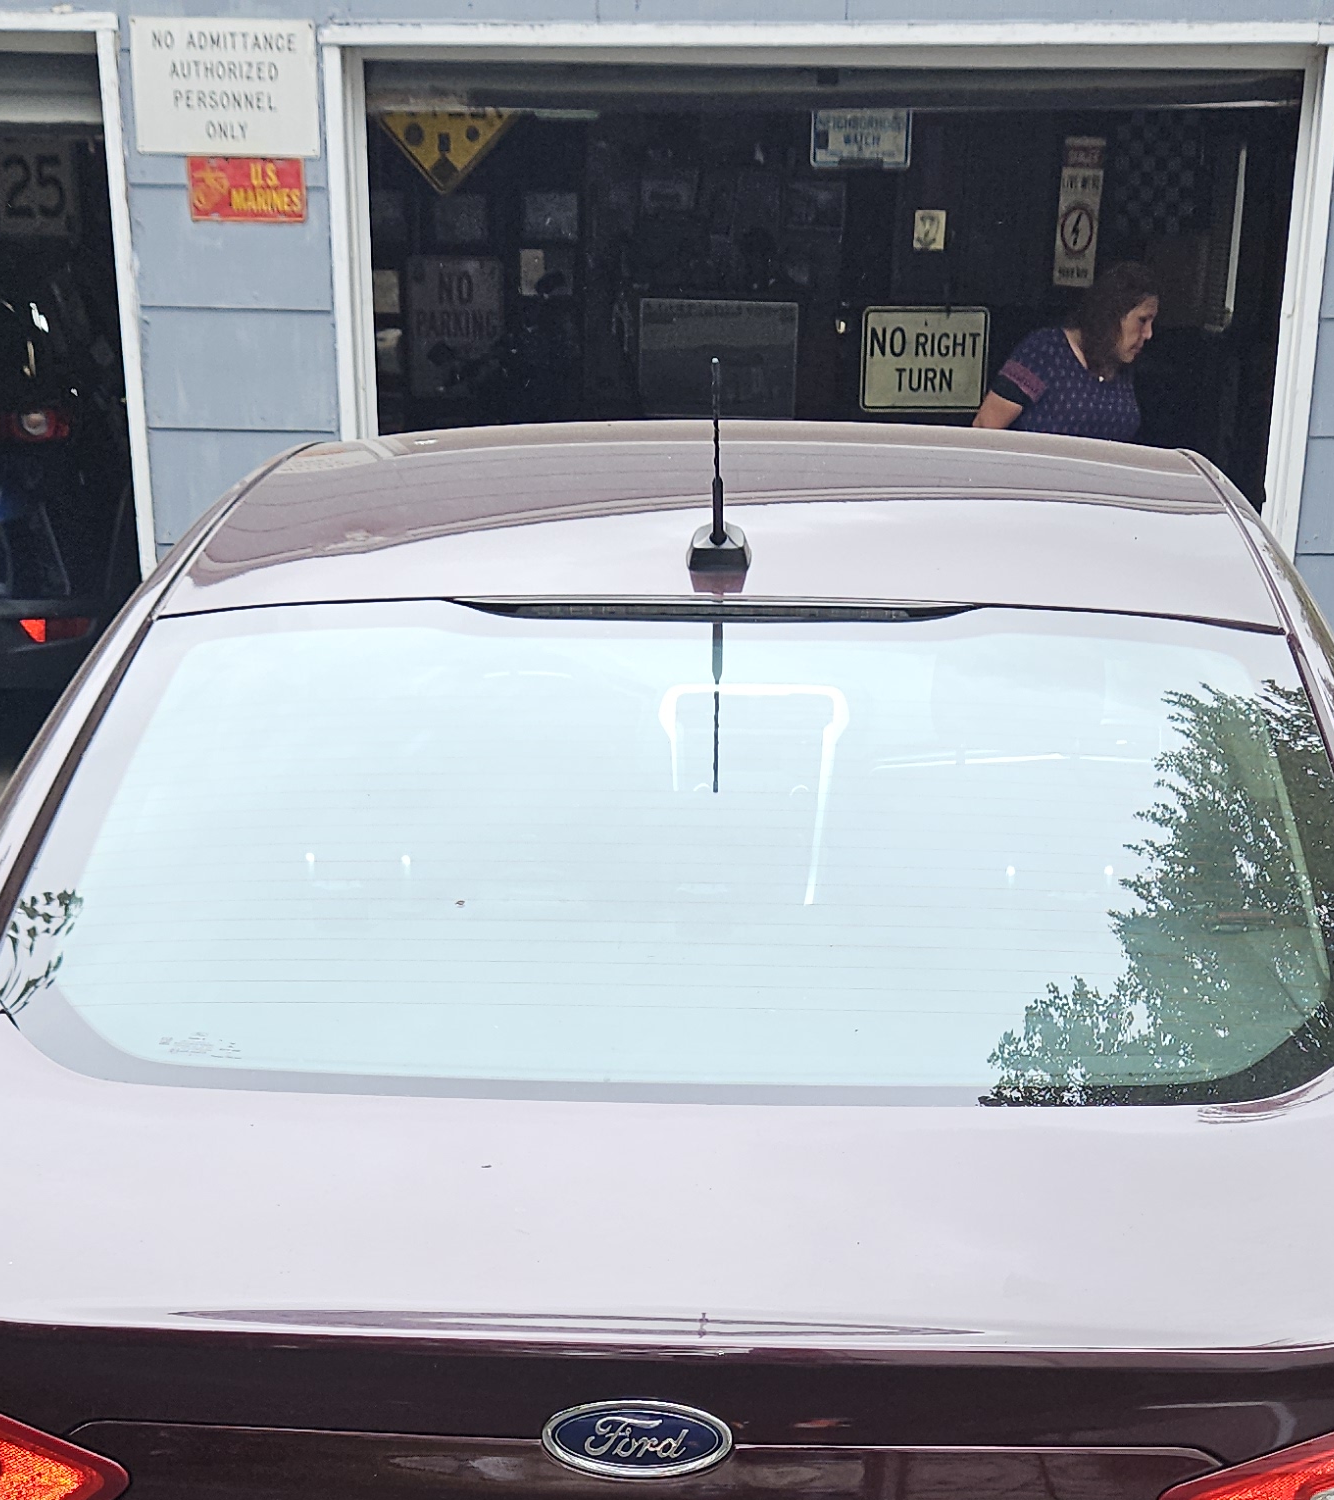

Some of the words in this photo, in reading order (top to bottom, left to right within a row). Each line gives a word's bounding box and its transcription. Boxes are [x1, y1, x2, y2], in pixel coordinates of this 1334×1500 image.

[151, 29, 175, 50] NO
[186, 31, 298, 52] ADMITTANCE
[168, 60, 280, 82] AUTHORIZED
[173, 89, 279, 112] PERSONNEL
[204, 120, 249, 141] ONLY
[2, 153, 66, 219] 25
[230, 187, 302, 213] MARINES
[437, 270, 474, 305] NO
[415, 308, 499, 338] PARKING
[869, 326, 907, 358] NO
[914, 332, 982, 359] RIGHT
[894, 367, 954, 393] TURN
[584, 1415, 690, 1459] Ford
